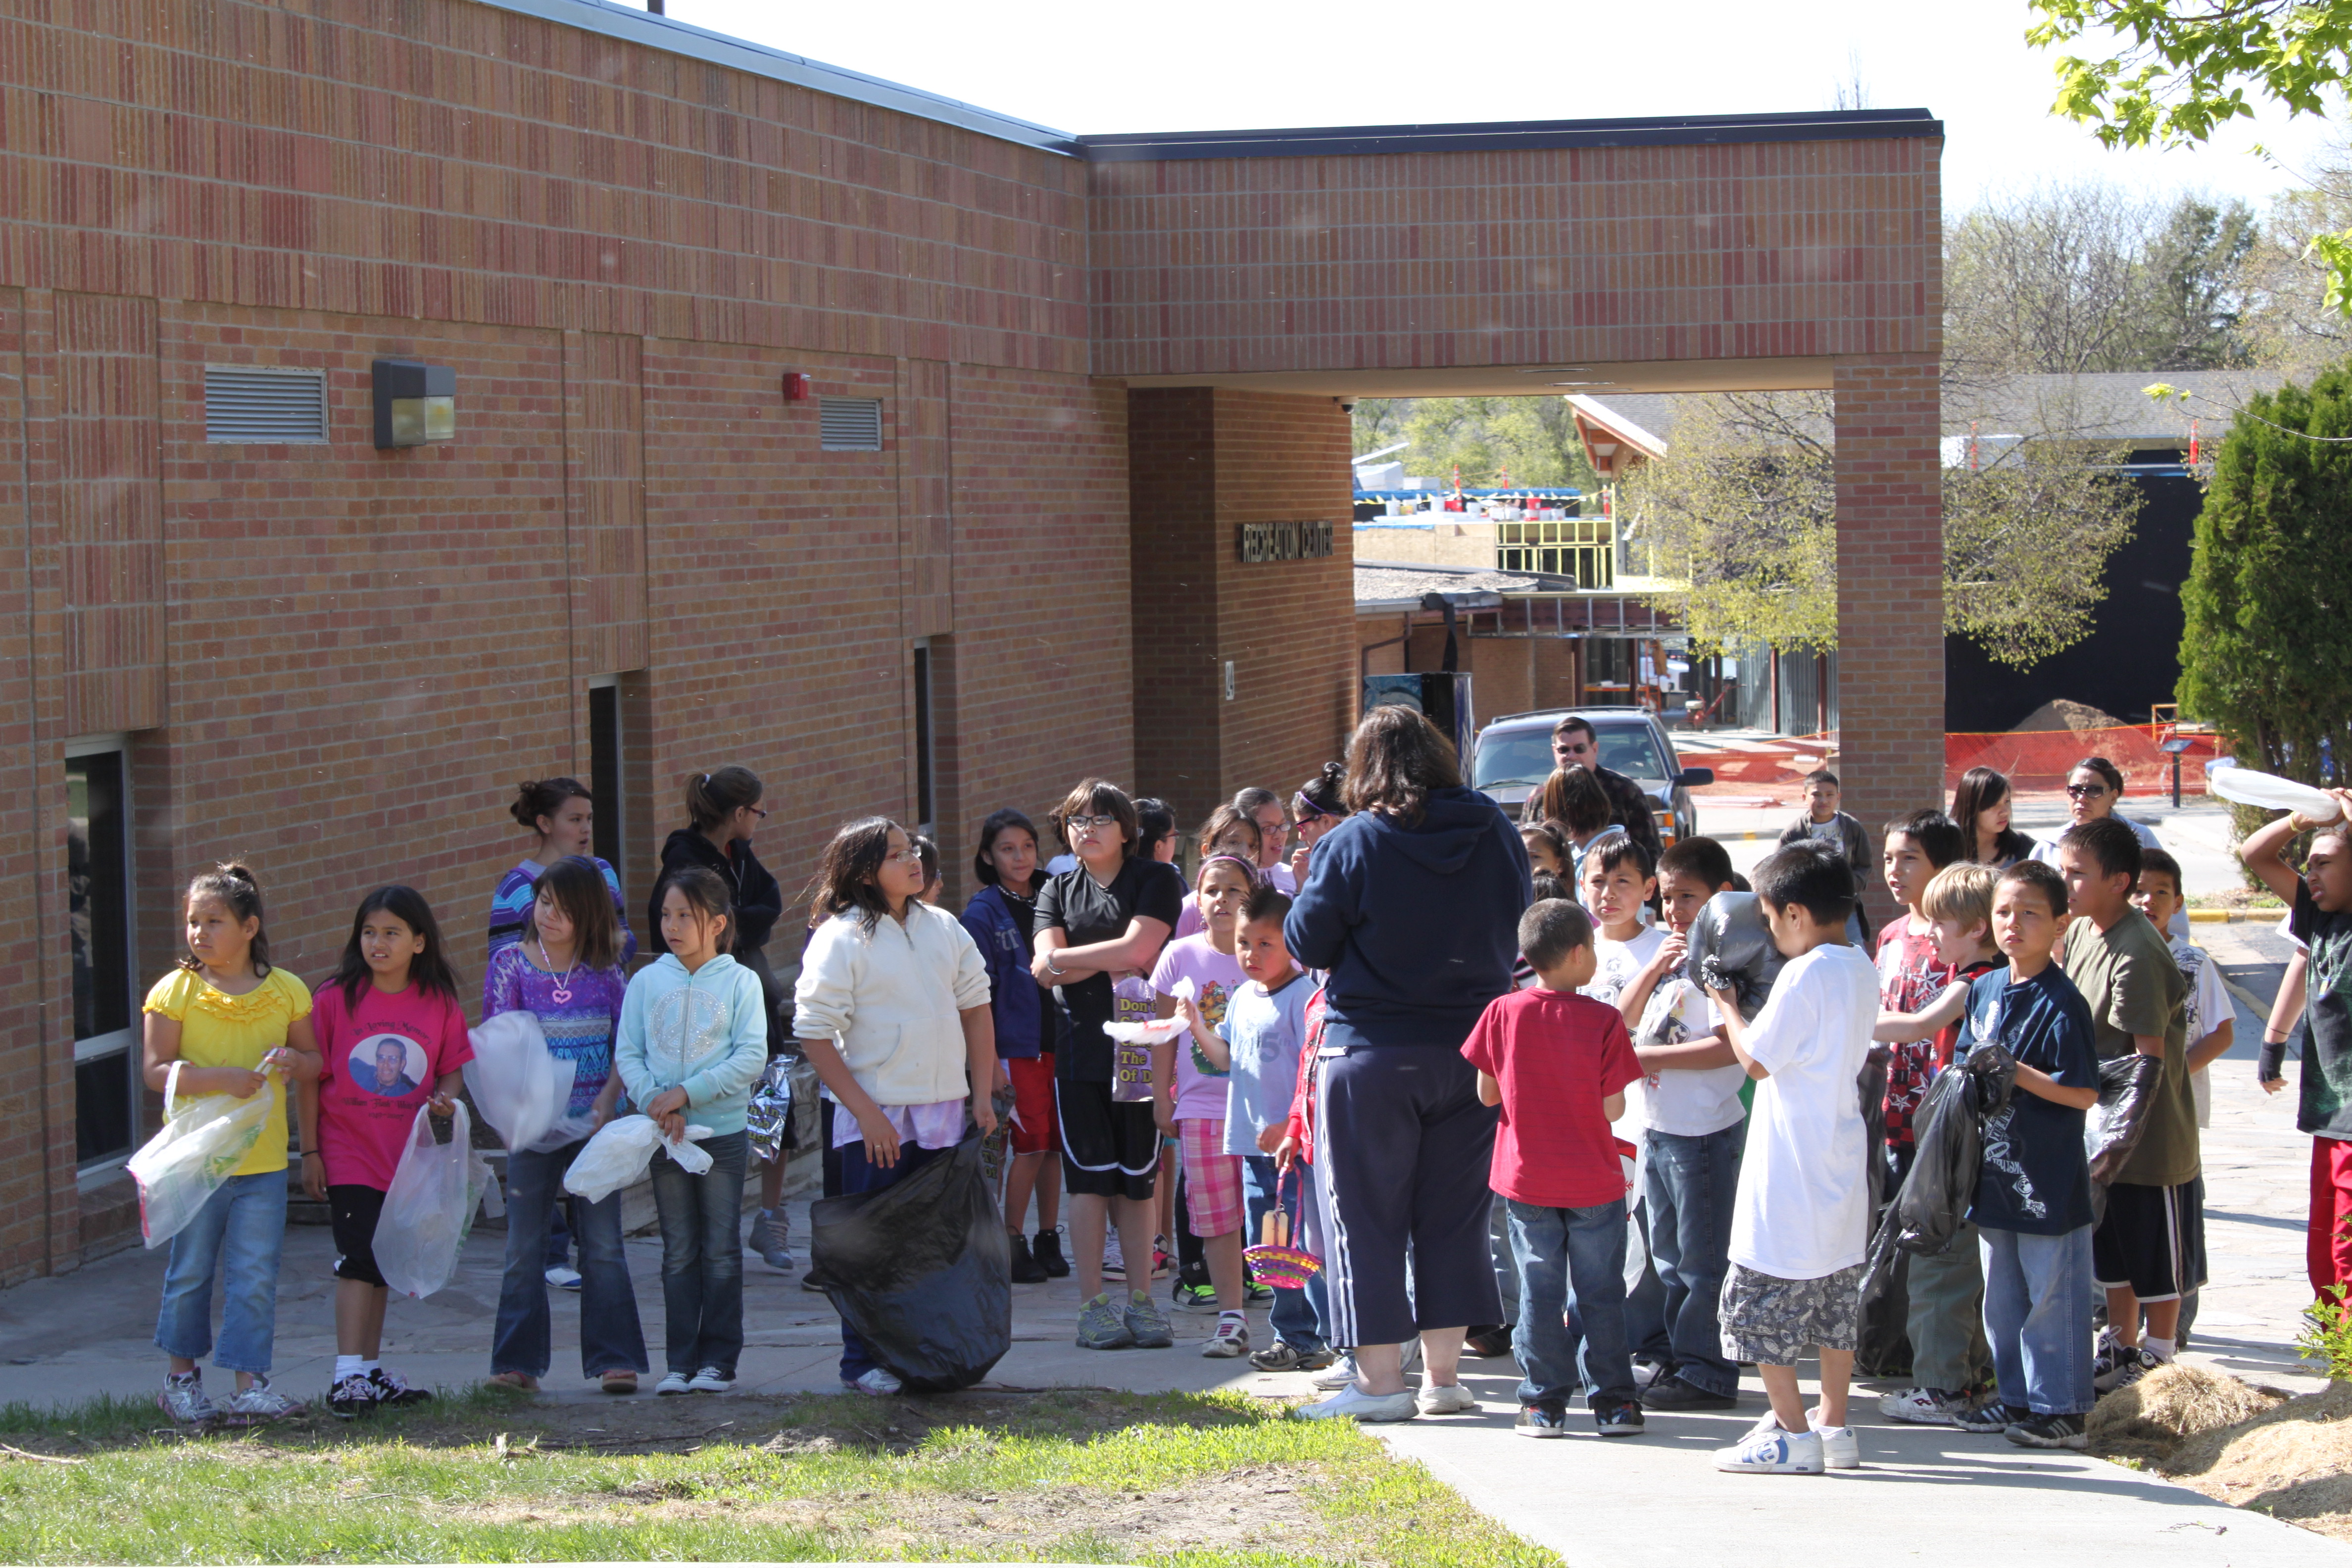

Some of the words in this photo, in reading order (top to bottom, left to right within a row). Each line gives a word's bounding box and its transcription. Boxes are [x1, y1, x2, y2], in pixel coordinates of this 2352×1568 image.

[1244, 522, 1299, 563] RECREATION
[1302, 521, 1332, 559] CENTER
[365, 1020, 395, 1031] Loving
[397, 1021, 433, 1046] Memory
[1121, 1051, 1147, 1064] The
[1120, 1069, 1138, 1082] Of
[765, 1105, 779, 1117] In
[982, 1151, 998, 1165] Th
